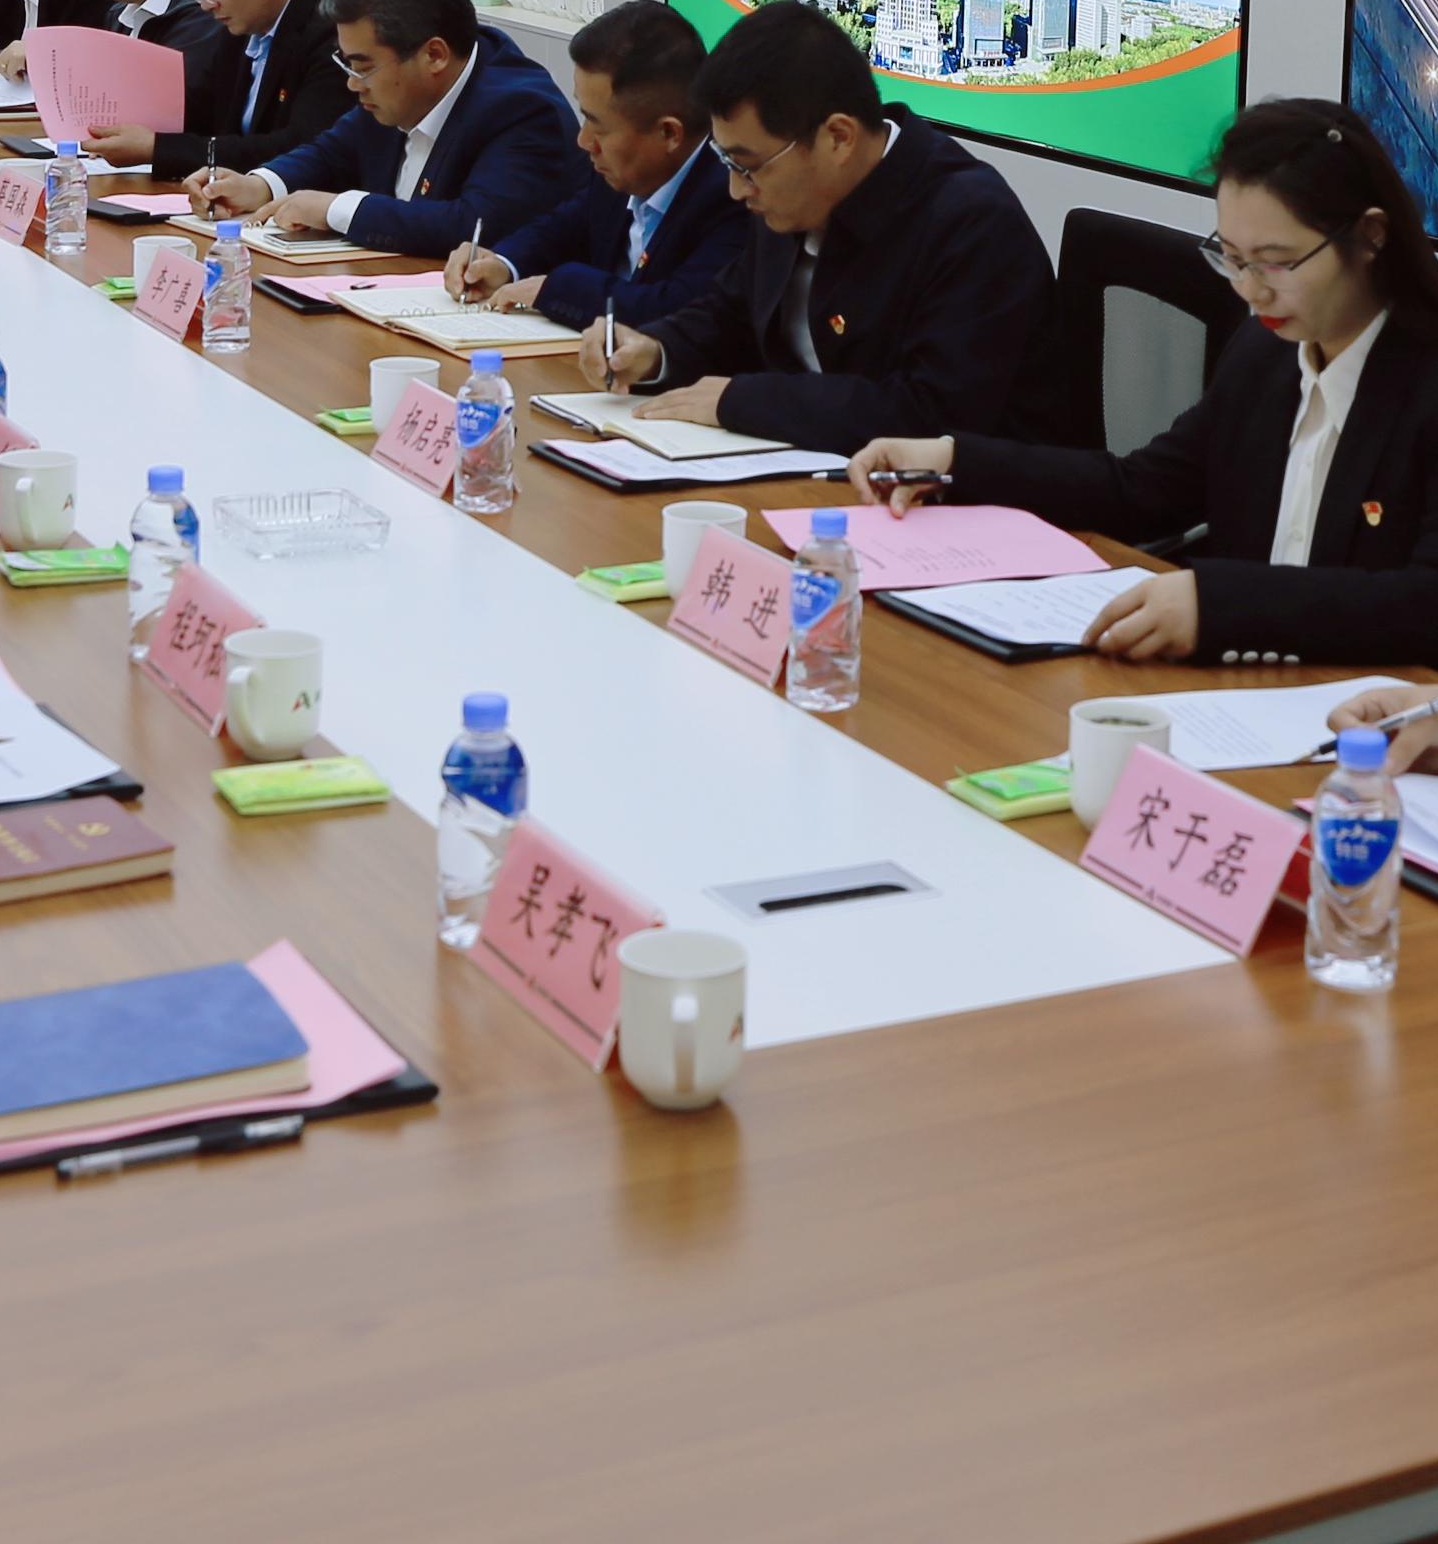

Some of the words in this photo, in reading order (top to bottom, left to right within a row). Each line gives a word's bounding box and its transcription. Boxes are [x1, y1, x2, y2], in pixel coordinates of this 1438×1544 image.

[701, 559, 780, 639] 韩进
[1123, 786, 1254, 898] 宋于磊
